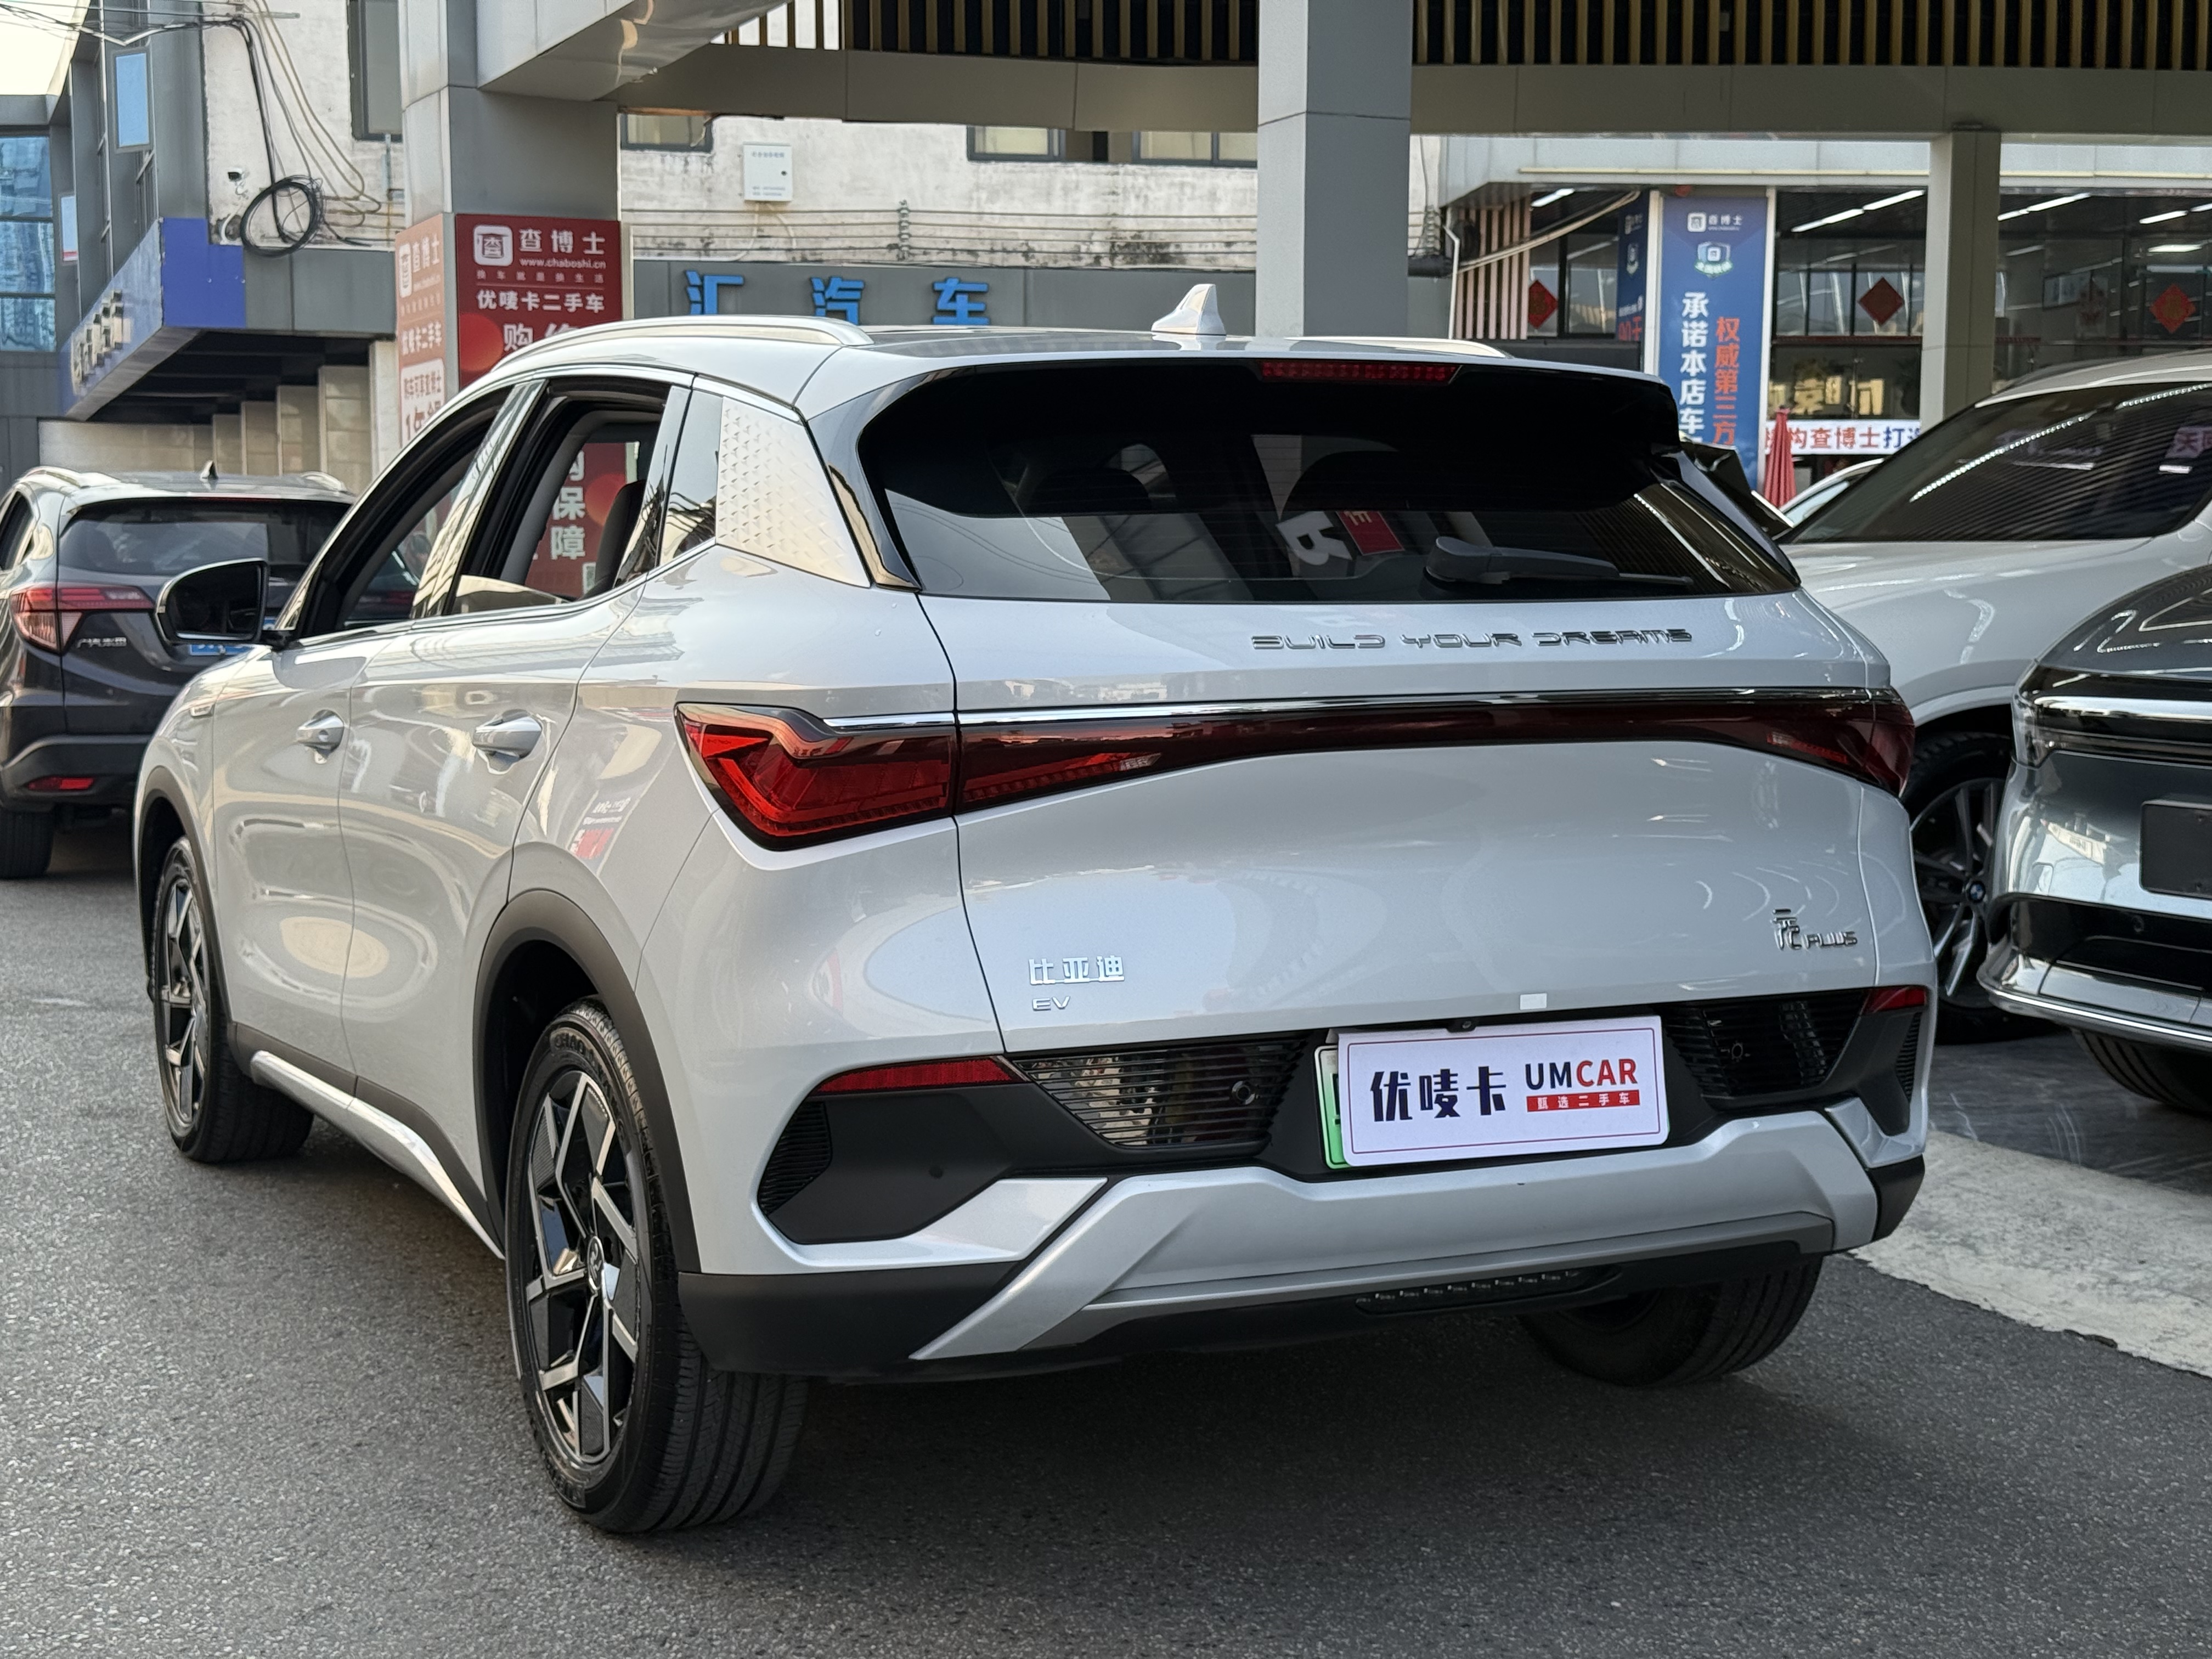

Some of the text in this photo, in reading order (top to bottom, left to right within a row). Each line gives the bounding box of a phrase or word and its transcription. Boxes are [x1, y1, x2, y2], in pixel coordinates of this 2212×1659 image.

[520, 228, 606, 255] 查博士
[520, 258, 607, 269] www.chaboshi.cn
[476, 289, 605, 313] 优唛卡二手车
[1678, 291, 1709, 442] 承诺本店车
[1712, 316, 1740, 445] 权威第三方
[1250, 628, 1693, 650] BUILD YOUR DREAMS
[1802, 931, 1858, 950] PLUS
[1029, 955, 1125, 986] 比亚迪
[1032, 996, 1071, 1011] EV
[1370, 1058, 1639, 1122] 优唛卡 UMCAR
[1537, 1092, 1630, 1110] 甄选二手车
